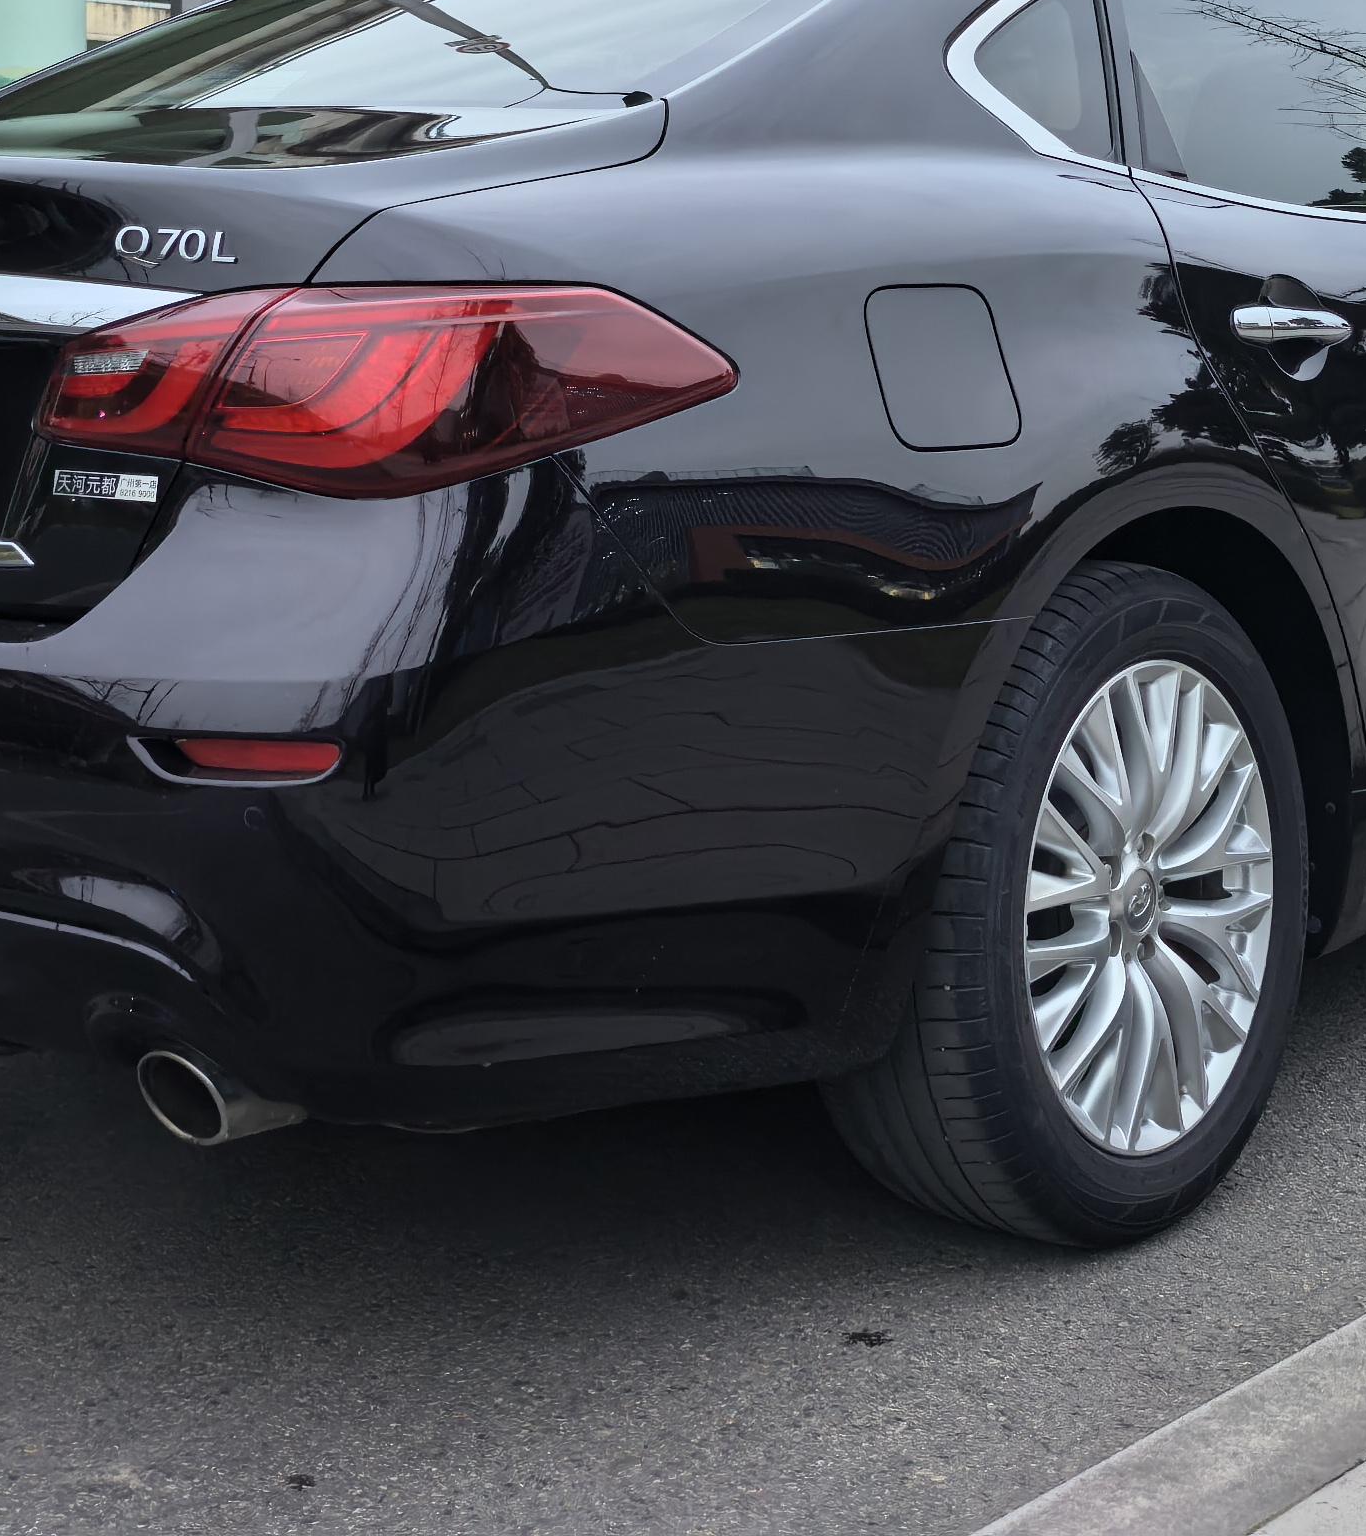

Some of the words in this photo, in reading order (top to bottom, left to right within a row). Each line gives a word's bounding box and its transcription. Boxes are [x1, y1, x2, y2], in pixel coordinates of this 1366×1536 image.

[115, 225, 236, 269] Q70L
[57, 474, 117, 495] 天河元都
